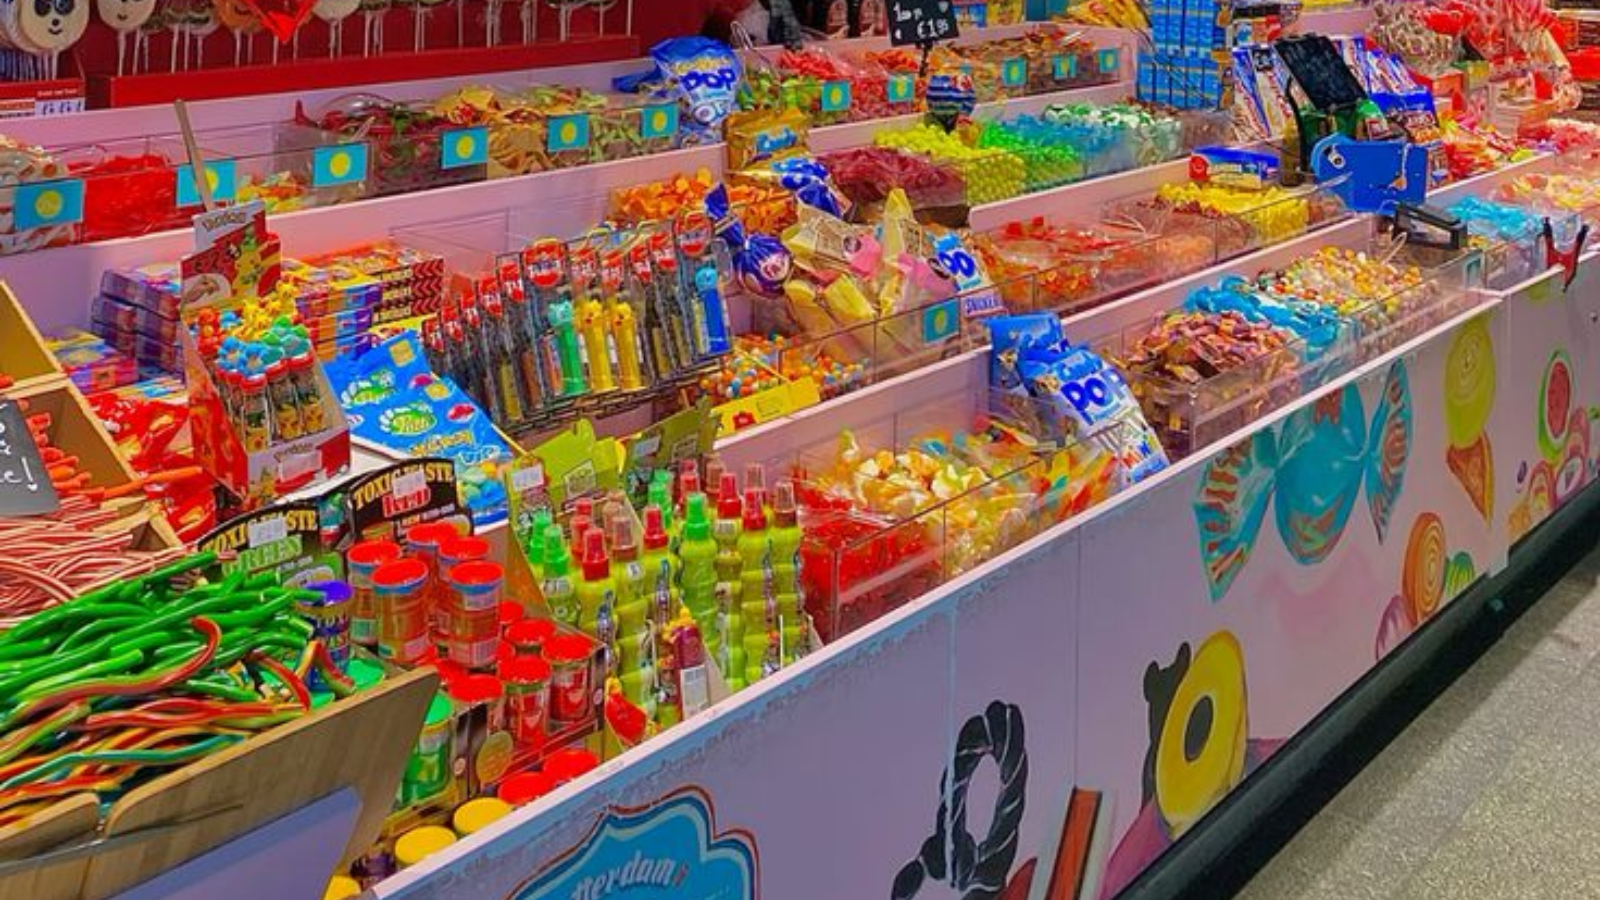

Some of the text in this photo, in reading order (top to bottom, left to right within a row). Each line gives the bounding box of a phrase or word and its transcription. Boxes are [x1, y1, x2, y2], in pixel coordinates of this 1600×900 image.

[681, 68, 736, 91] POP
[353, 470, 404, 511] TOXI
[201, 518, 256, 555] TOXI
[569, 849, 676, 900] tterdam
